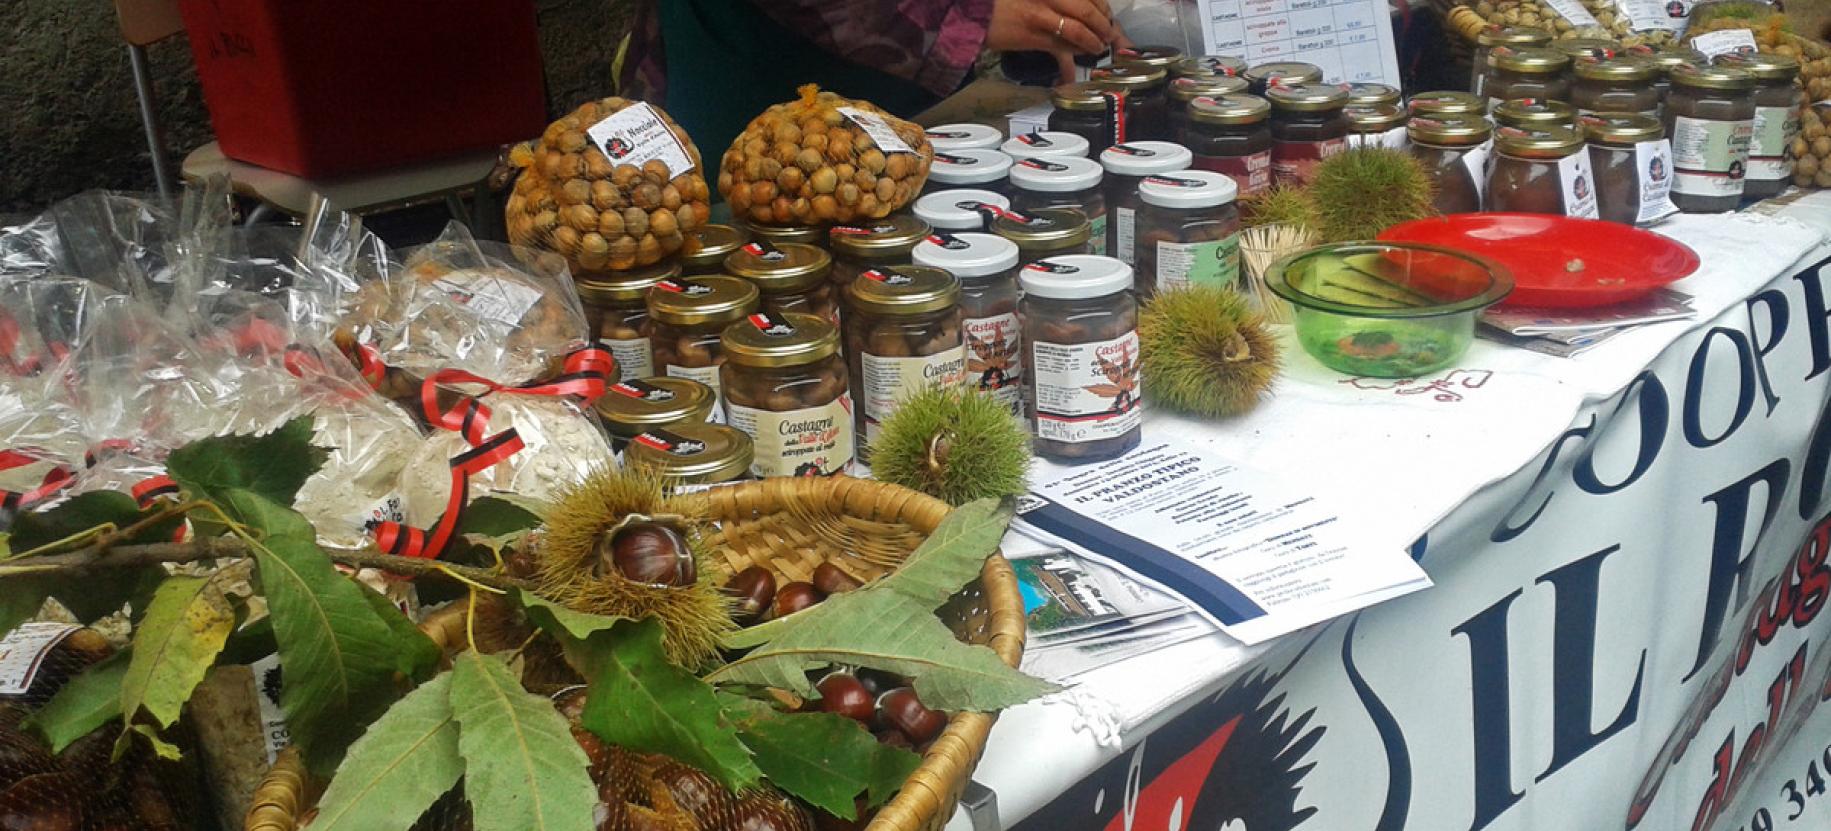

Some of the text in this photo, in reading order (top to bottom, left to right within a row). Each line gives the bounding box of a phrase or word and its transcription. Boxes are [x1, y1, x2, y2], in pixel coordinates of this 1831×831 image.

[1074, 493, 1094, 503] IL
[1094, 473, 1152, 498] PRANZO
[1153, 455, 1202, 474] TIPICO
[1102, 466, 1200, 503] VALDOSTANO
[1451, 542, 1648, 831] IL
